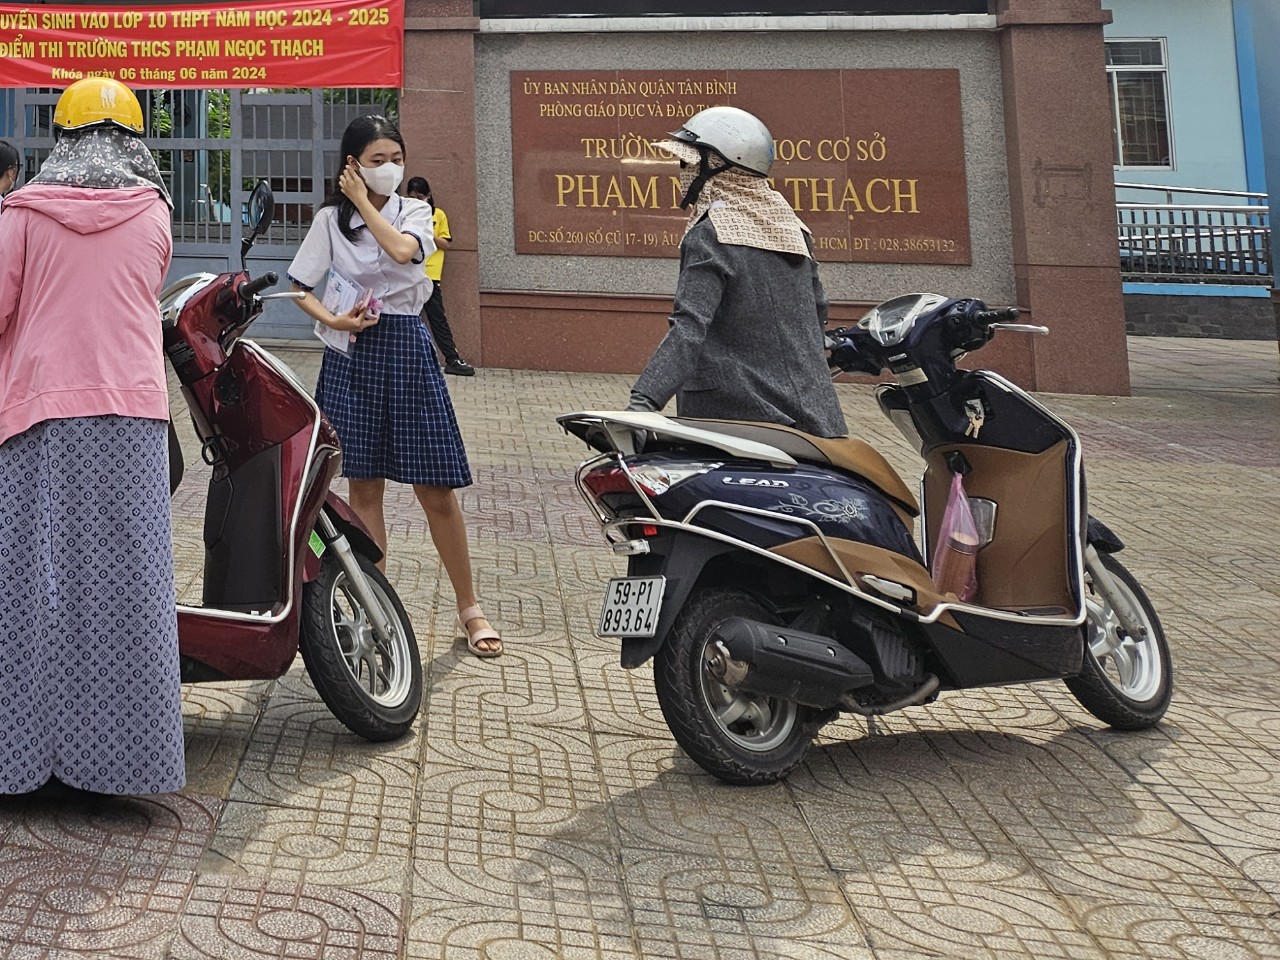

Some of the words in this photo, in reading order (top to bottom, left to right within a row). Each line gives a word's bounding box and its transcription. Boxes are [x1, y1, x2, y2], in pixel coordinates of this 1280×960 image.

[42, 13, 76, 29] SINH
[80, 11, 110, 29] VÀO
[114, 11, 143, 28] LỚP
[148, 12, 166, 28] 10
[171, 10, 211, 27] THPT
[215, 8, 250, 27] NĂM
[255, 9, 287, 30] HỌC
[292, 8, 332, 26] 2024
[348, 8, 389, 26] 2025
[39, 41, 63, 58] THI
[67, 37, 128, 58] TRƯỜNG
[131, 41, 170, 57] THCS
[176, 40, 220, 60] PHẠM
[224, 40, 266, 60] NGỌC
[271, 39, 324, 60] THẠCH
[51, 67, 83, 79] Khóa
[120, 68, 136, 79] 06
[140, 68, 176, 81] tháng
[180, 68, 197, 79] 06
[201, 69, 228, 79] năm
[232, 67, 267, 79] 2024
[523, 77, 542, 94] ỦY
[544, 82, 569, 94] BAN
[572, 78, 607, 94] NHÂN
[609, 78, 636, 94] DÂN
[639, 78, 675, 97] QUẬN
[677, 78, 704, 94] TÂN
[706, 78, 737, 94] BÌNH
[540, 101, 581, 117] PHÒNG
[584, 100, 616, 117] GIÁO
[618, 104, 645, 120] DỤC
[647, 100, 664, 117] VÀ
[666, 100, 694, 117] ĐÀO
[817, 136, 850, 161] CƠ
[856, 132, 887, 161] SỞ
[555, 174, 661, 216] PHẠM
[784, 177, 921, 221] THẠCH
[528, 230, 548, 242] ĐC:
[549, 226, 564, 242] SỐ
[567, 231, 583, 243] 260
[821, 238, 848, 250] HCM
[880, 240, 955, 253] 028.38653132
[722, 476, 790, 488] LEAD
[613, 580, 654, 605] 59-P1
[602, 608, 652, 633] 893.64
